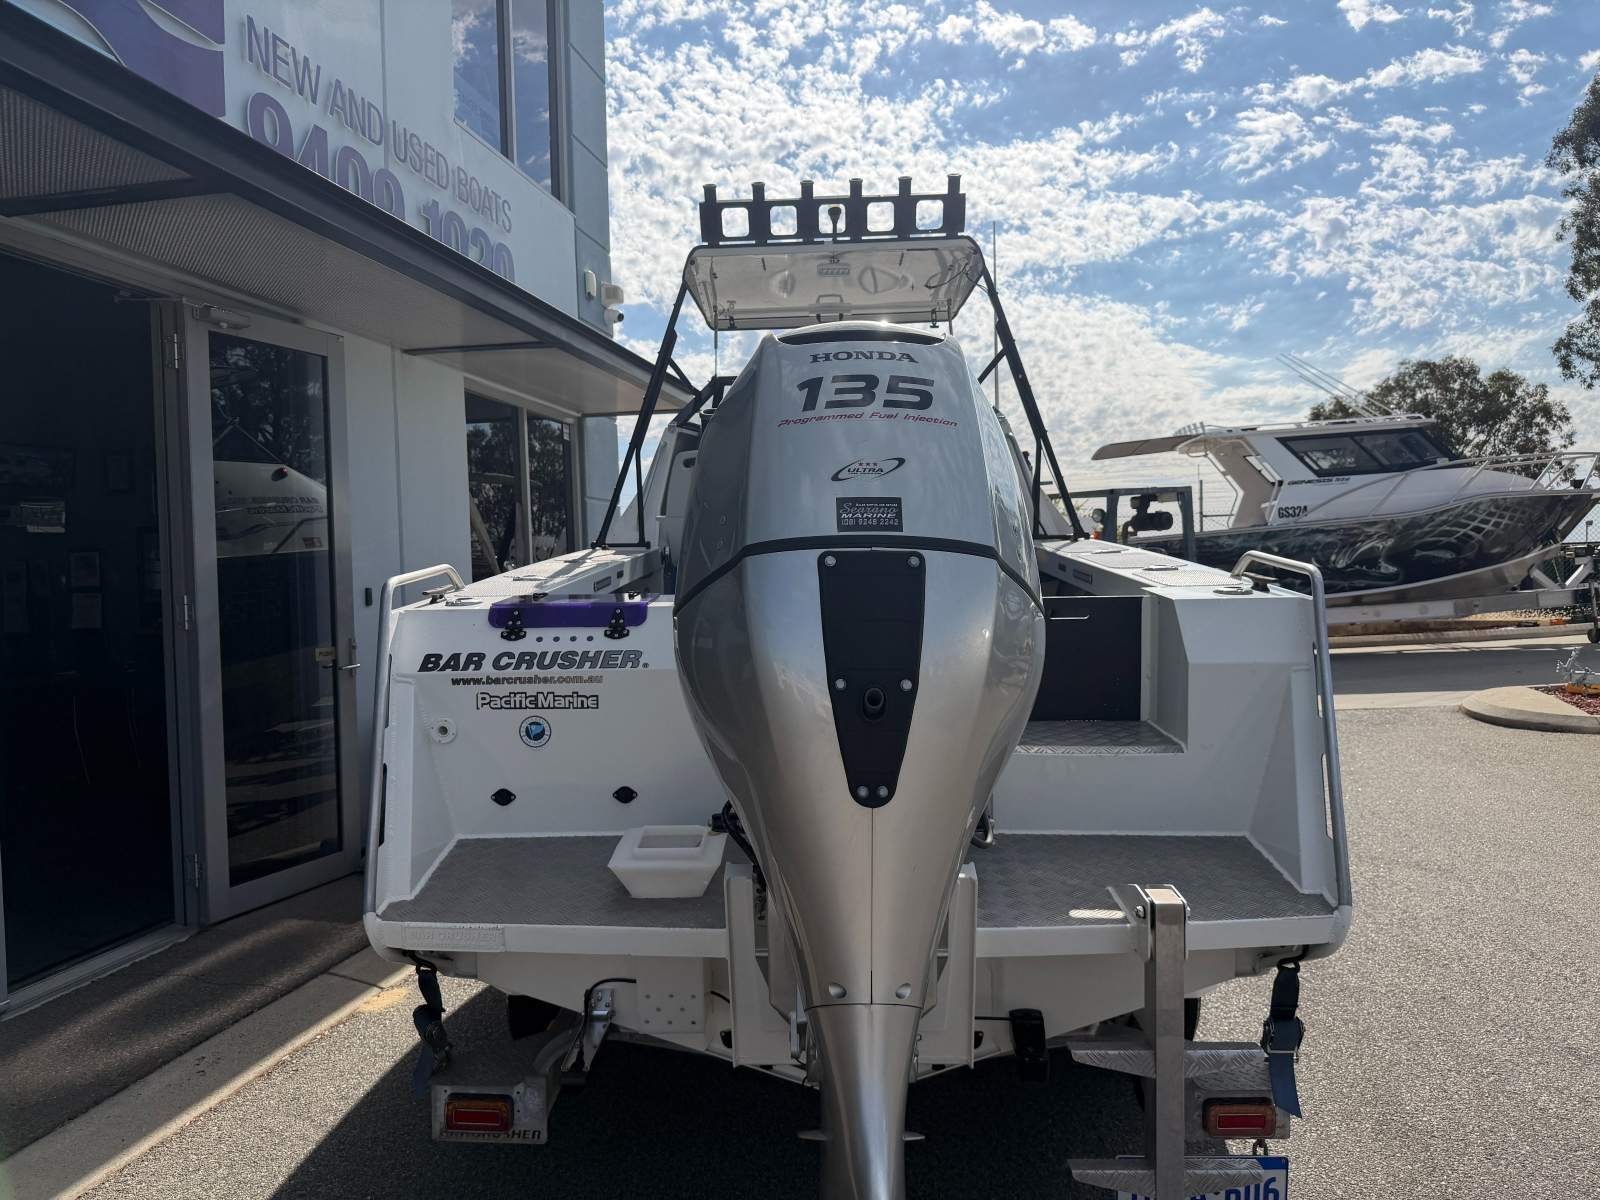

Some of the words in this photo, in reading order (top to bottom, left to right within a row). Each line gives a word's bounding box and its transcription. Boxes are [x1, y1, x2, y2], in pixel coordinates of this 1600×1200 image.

[246, 14, 321, 105] NEW
[328, 78, 384, 146] AND
[392, 119, 450, 190] USED
[457, 165, 512, 234] BOATS
[809, 350, 920, 363] HONDA
[796, 374, 935, 412] 135
[777, 411, 865, 428] Programmed
[869, 411, 899, 420] Fuel
[903, 413, 958, 427] Injection
[417, 652, 487, 673] BAR
[491, 649, 643, 671] CRUSHER
[450, 675, 604, 686] www.barcrusher.com.au
